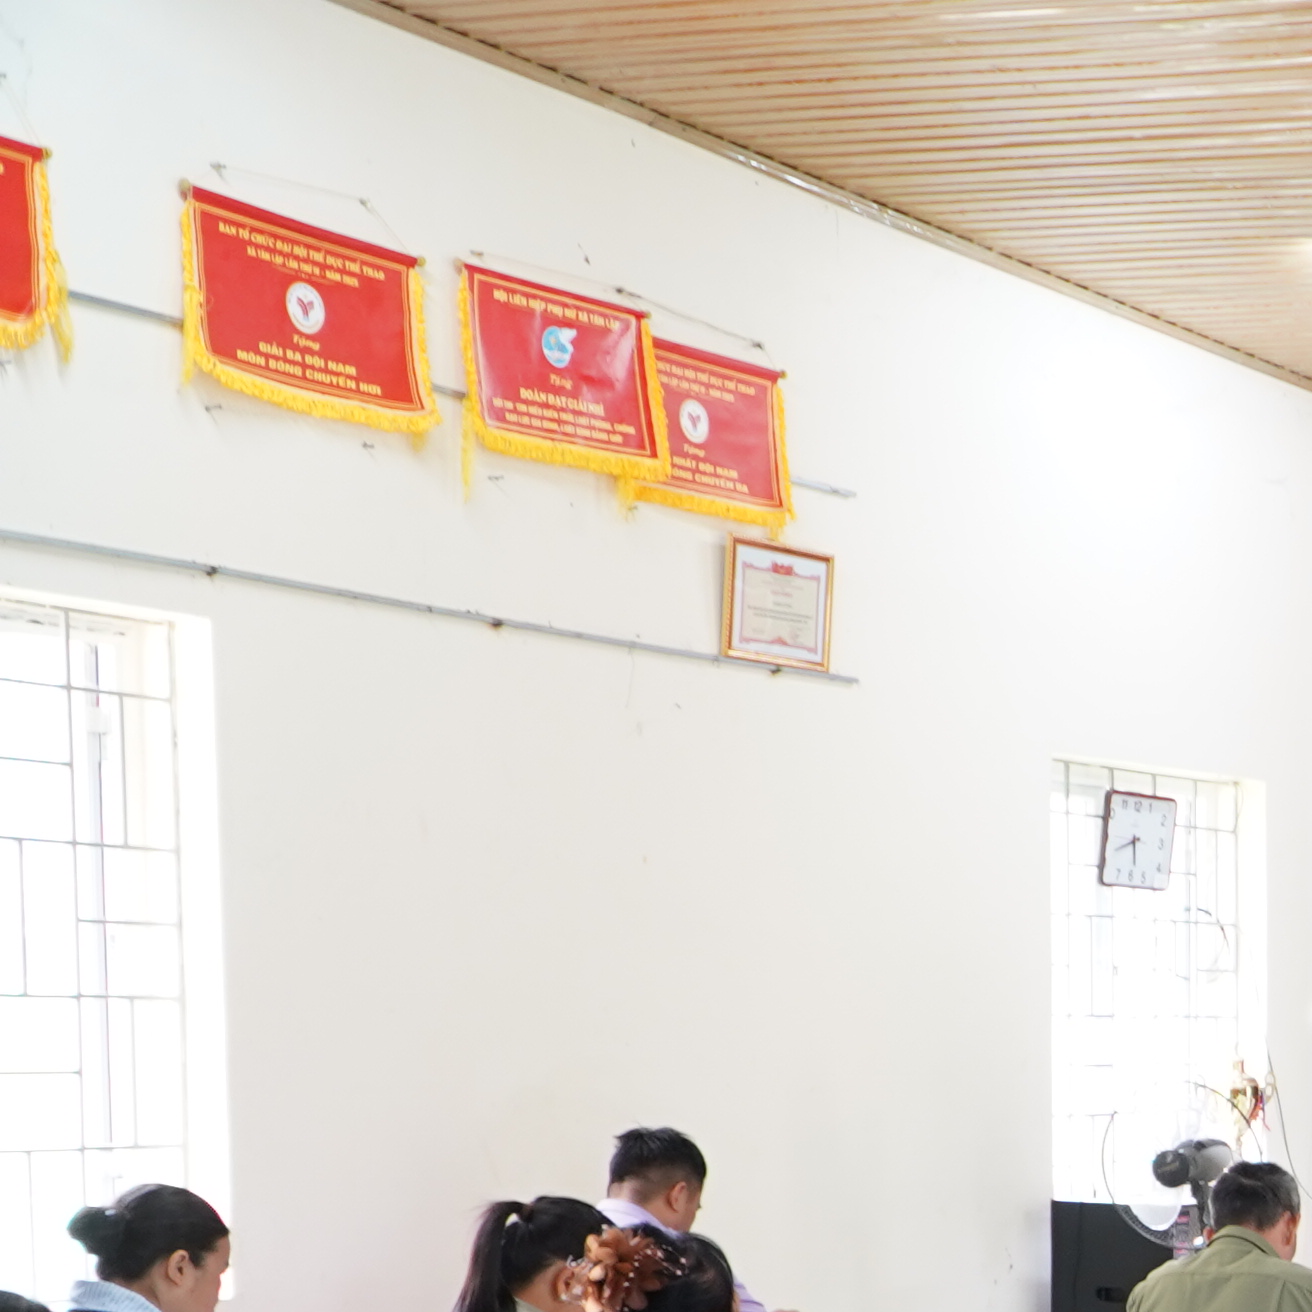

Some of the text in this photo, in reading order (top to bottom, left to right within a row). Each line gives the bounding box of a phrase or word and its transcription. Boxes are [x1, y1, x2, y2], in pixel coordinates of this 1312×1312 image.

[236, 348, 266, 367] MÔN
[268, 356, 302, 377] BÓNG
[305, 368, 357, 391] CHUYỀN
[258, 340, 357, 377] GIẢI BA ĐỘI NAM
